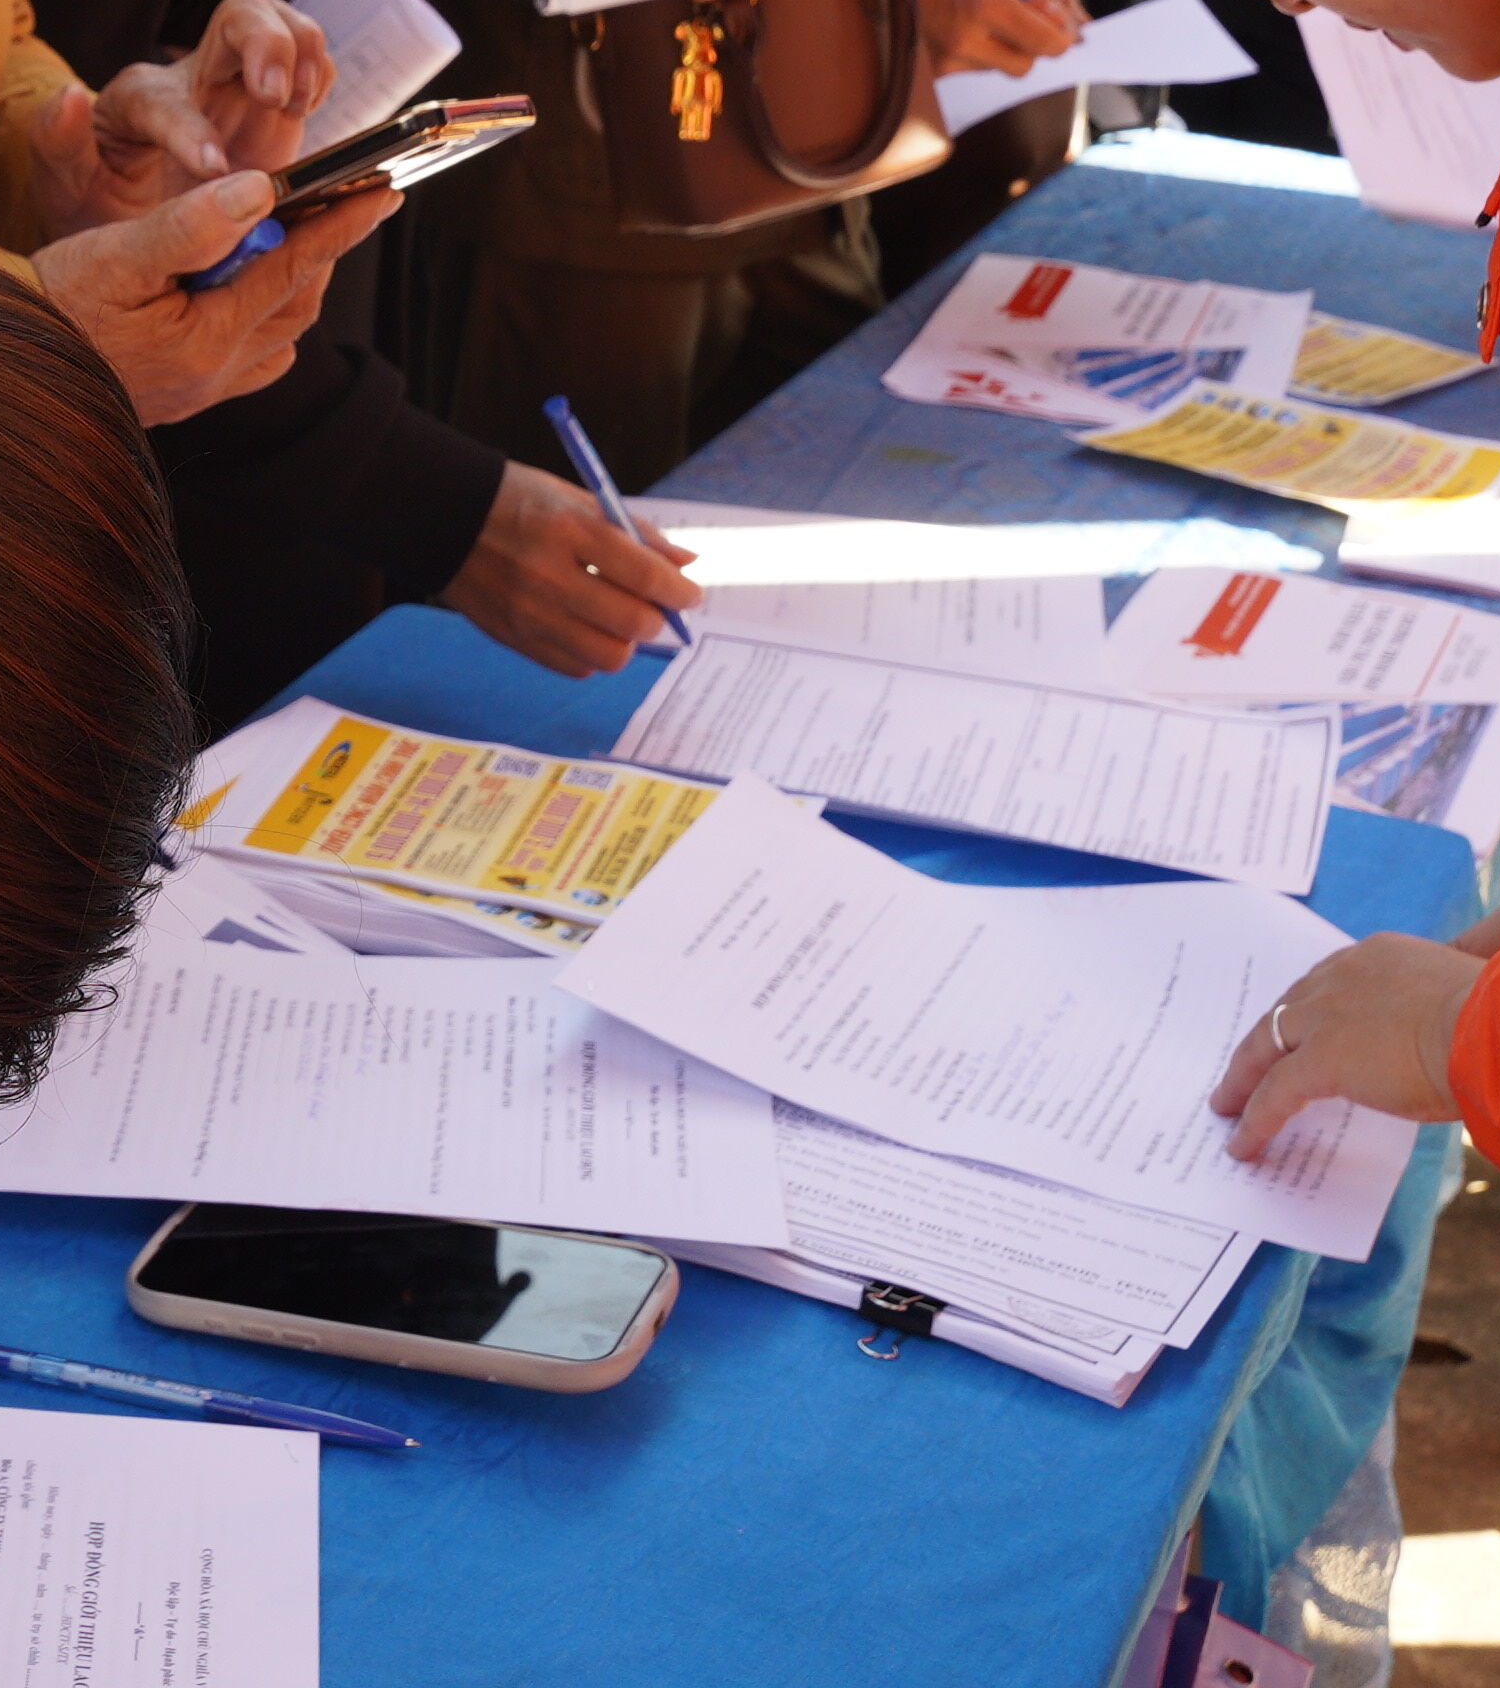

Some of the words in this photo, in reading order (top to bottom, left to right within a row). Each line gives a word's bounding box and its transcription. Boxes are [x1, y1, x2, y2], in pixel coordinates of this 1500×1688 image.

[84, 1521, 106, 1549] HỢP
[83, 1551, 108, 1587] ĐỒNG
[79, 1591, 102, 1620] GIỚI
[72, 1624, 97, 1662] THIỆU
